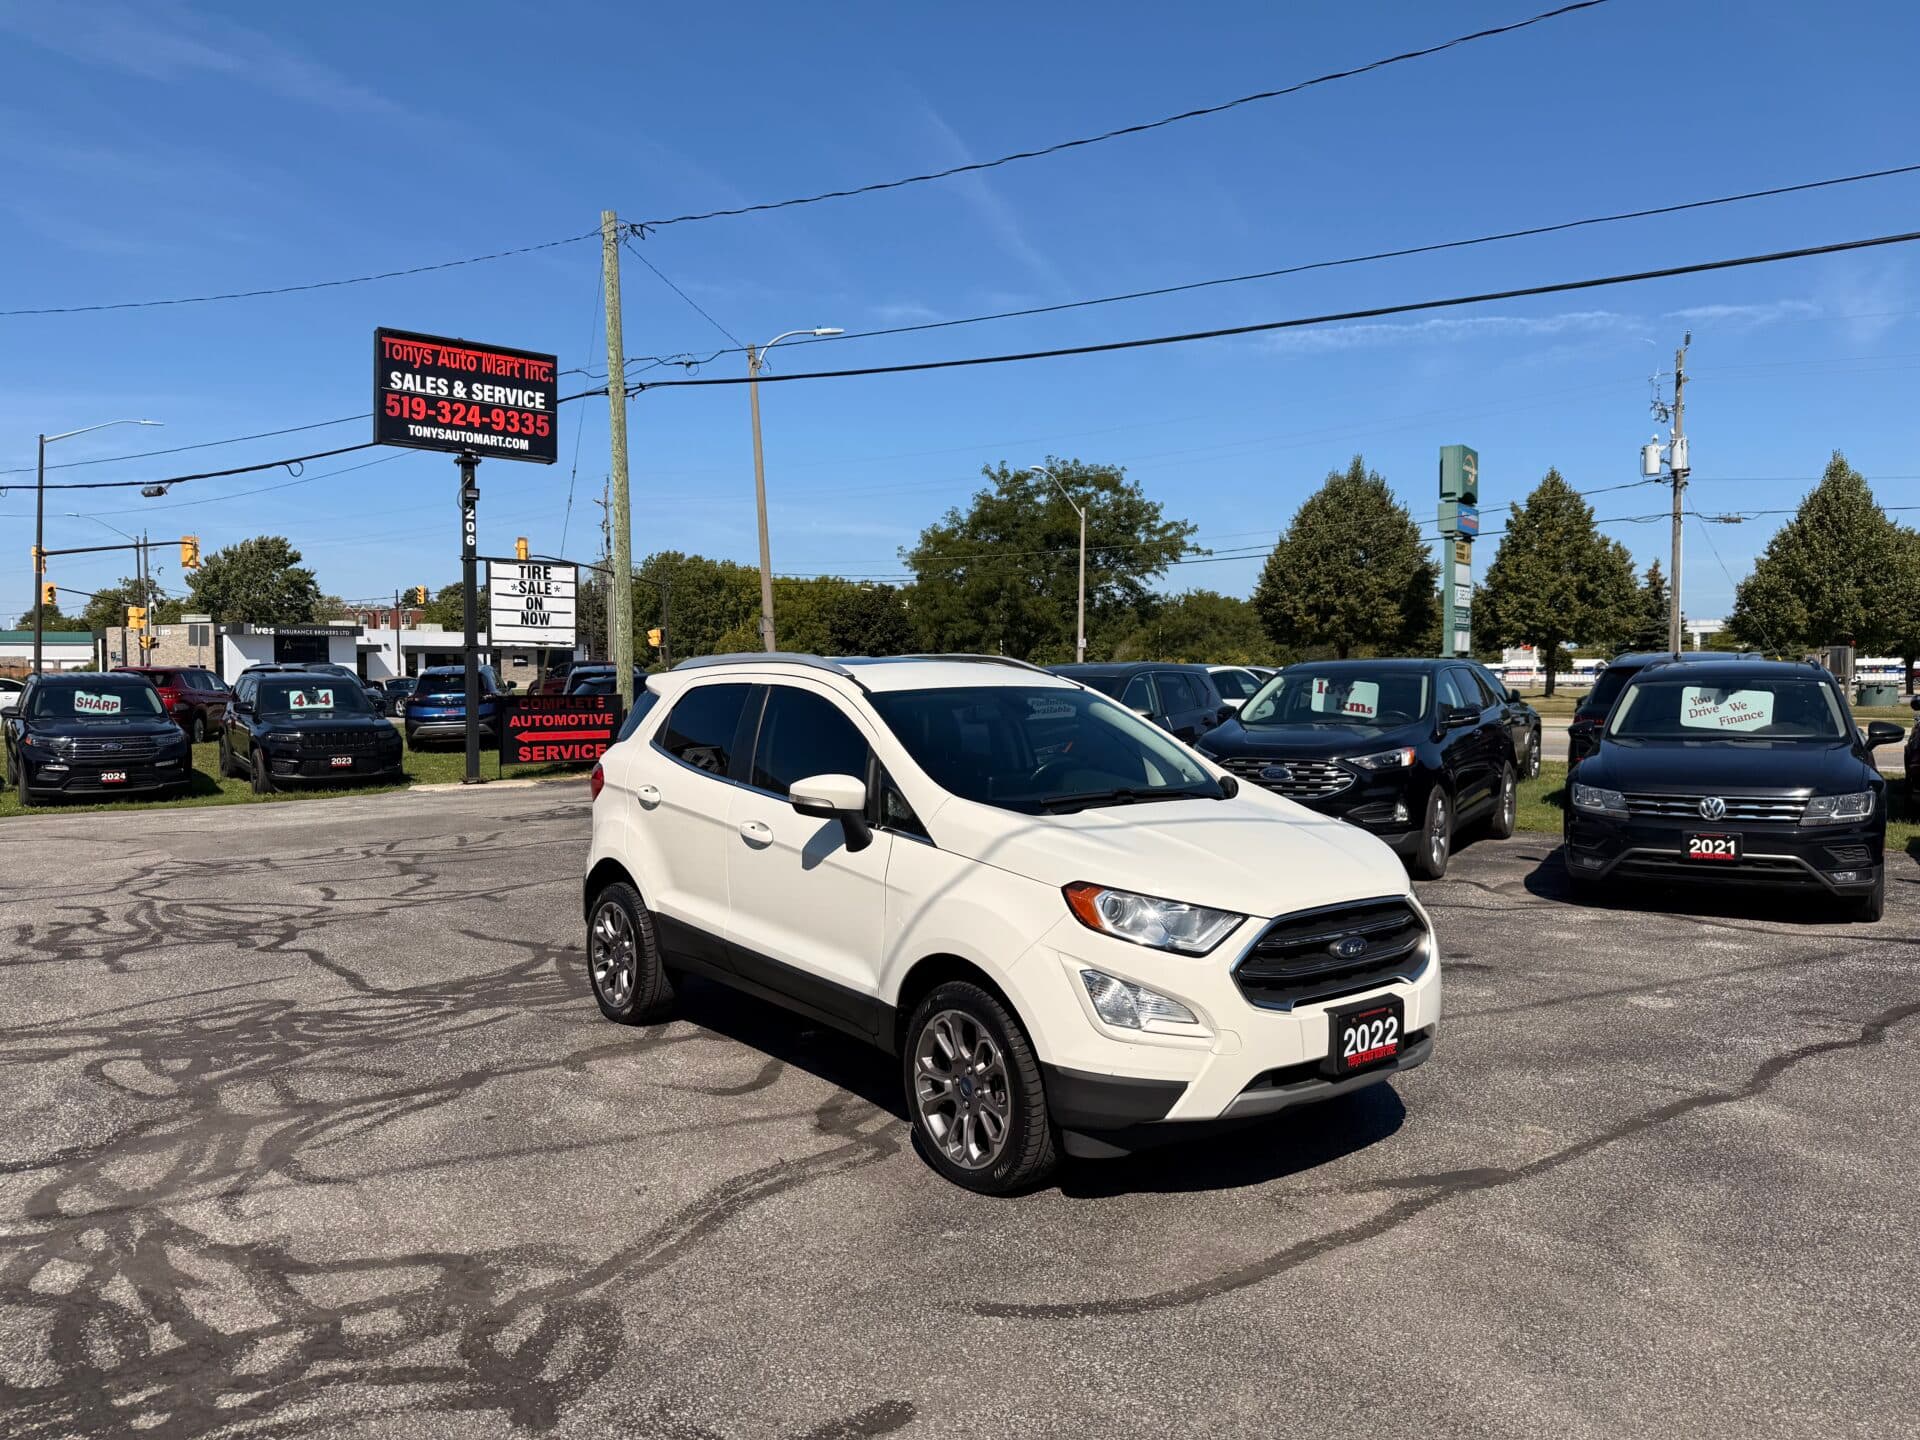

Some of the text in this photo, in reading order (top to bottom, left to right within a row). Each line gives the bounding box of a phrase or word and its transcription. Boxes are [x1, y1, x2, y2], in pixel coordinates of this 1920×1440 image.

[384, 337, 554, 383] Tonys Auto Mart Inc.
[390, 371, 546, 409] SALES & SERVICE
[385, 393, 550, 437] 519-324-9335
[408, 424, 529, 450] TONYSAUTOMART.COM
[465, 508, 476, 546] 206
[518, 565, 552, 580] TIRE
[518, 580, 552, 595] SALE
[525, 596, 543, 611] ON
[520, 611, 551, 626] NOW
[250, 623, 275, 635] ives
[76, 696, 119, 712] SHARP
[520, 696, 605, 710] COMPLETE
[1690, 695, 1712, 706] You
[1729, 701, 1748, 712] We
[1688, 704, 1720, 719] Drive
[1719, 710, 1765, 726] Finance
[509, 713, 614, 728] AUTOMOTIVE
[330, 757, 352, 765] 2023
[100, 772, 126, 781] 2024
[1689, 838, 1735, 856] 2021
[1343, 1015, 1399, 1058] 2022
